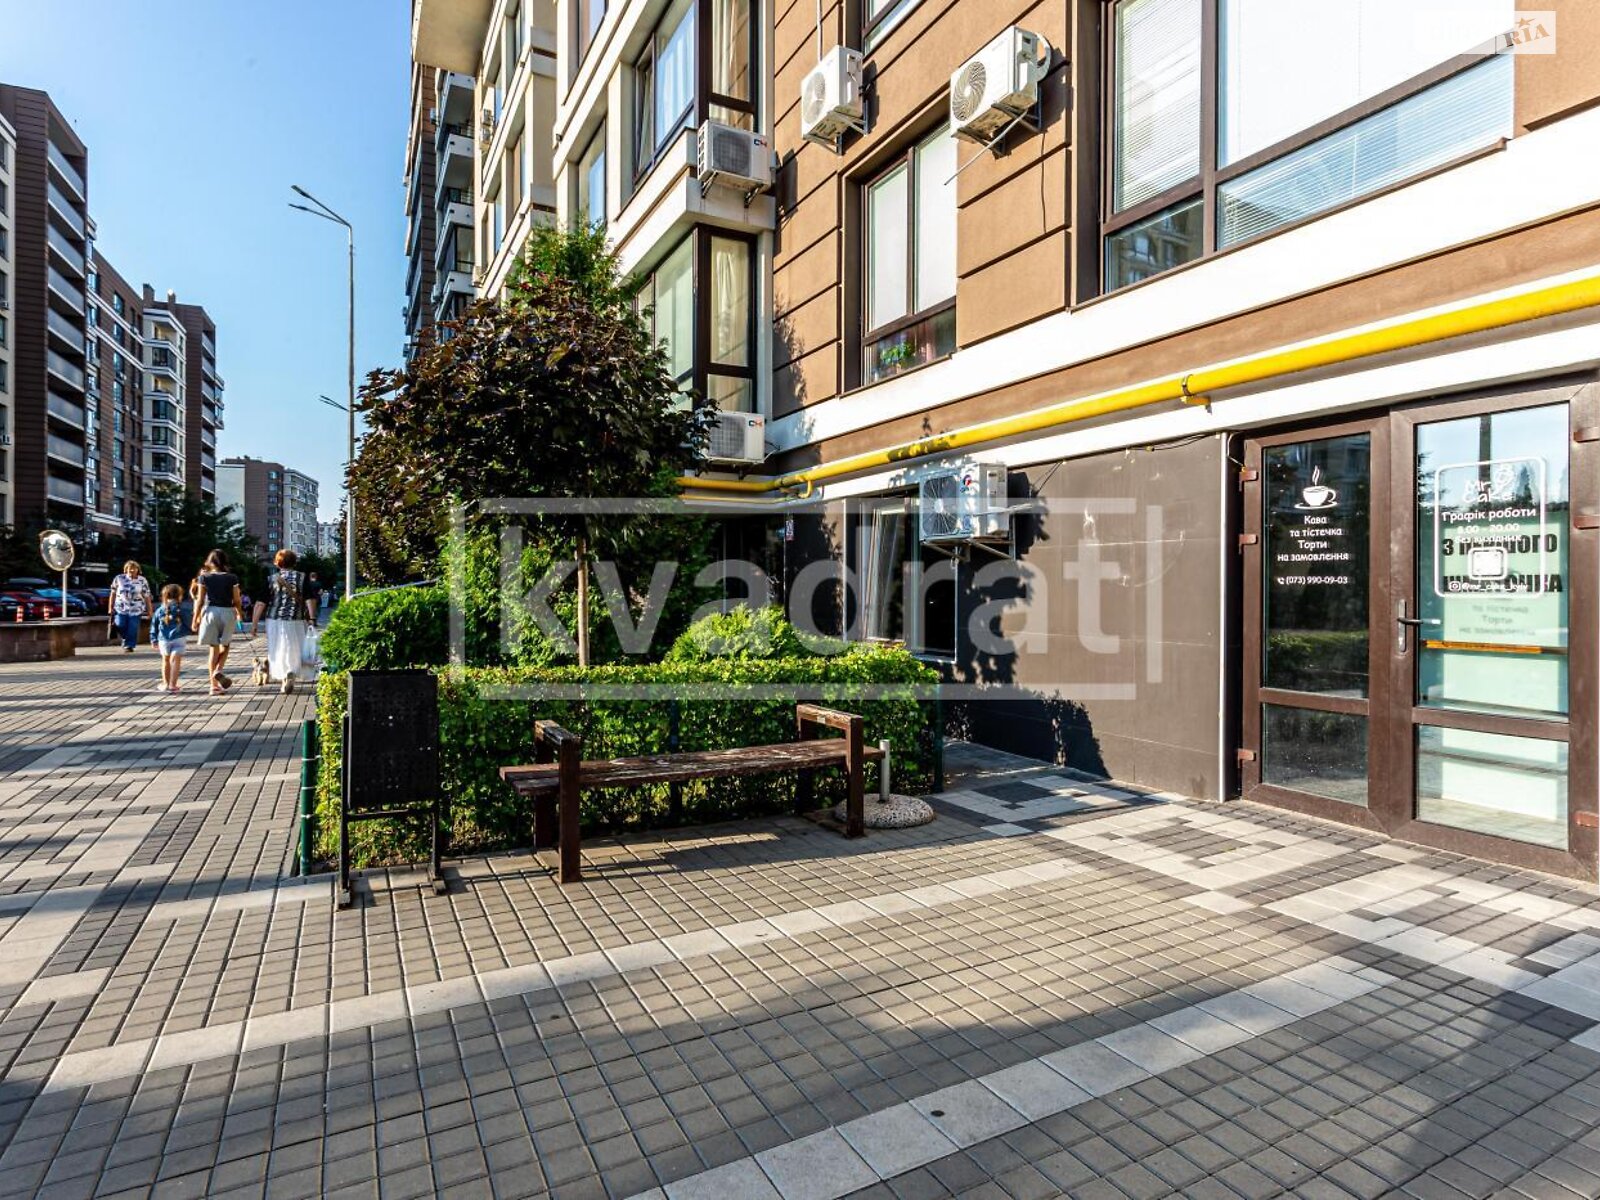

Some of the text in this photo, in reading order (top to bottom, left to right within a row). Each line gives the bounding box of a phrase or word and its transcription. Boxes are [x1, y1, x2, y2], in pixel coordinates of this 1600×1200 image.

[1465, 479, 1491, 491] Mr
[1304, 515, 1327, 524] Кава
[1441, 507, 1536, 523] Графік роботи
[1290, 528, 1342, 537] та тістечка
[1298, 540, 1327, 551] Торти
[1277, 552, 1349, 562] на замовлення
[1285, 575, 1348, 585] (073) 990-09-03
